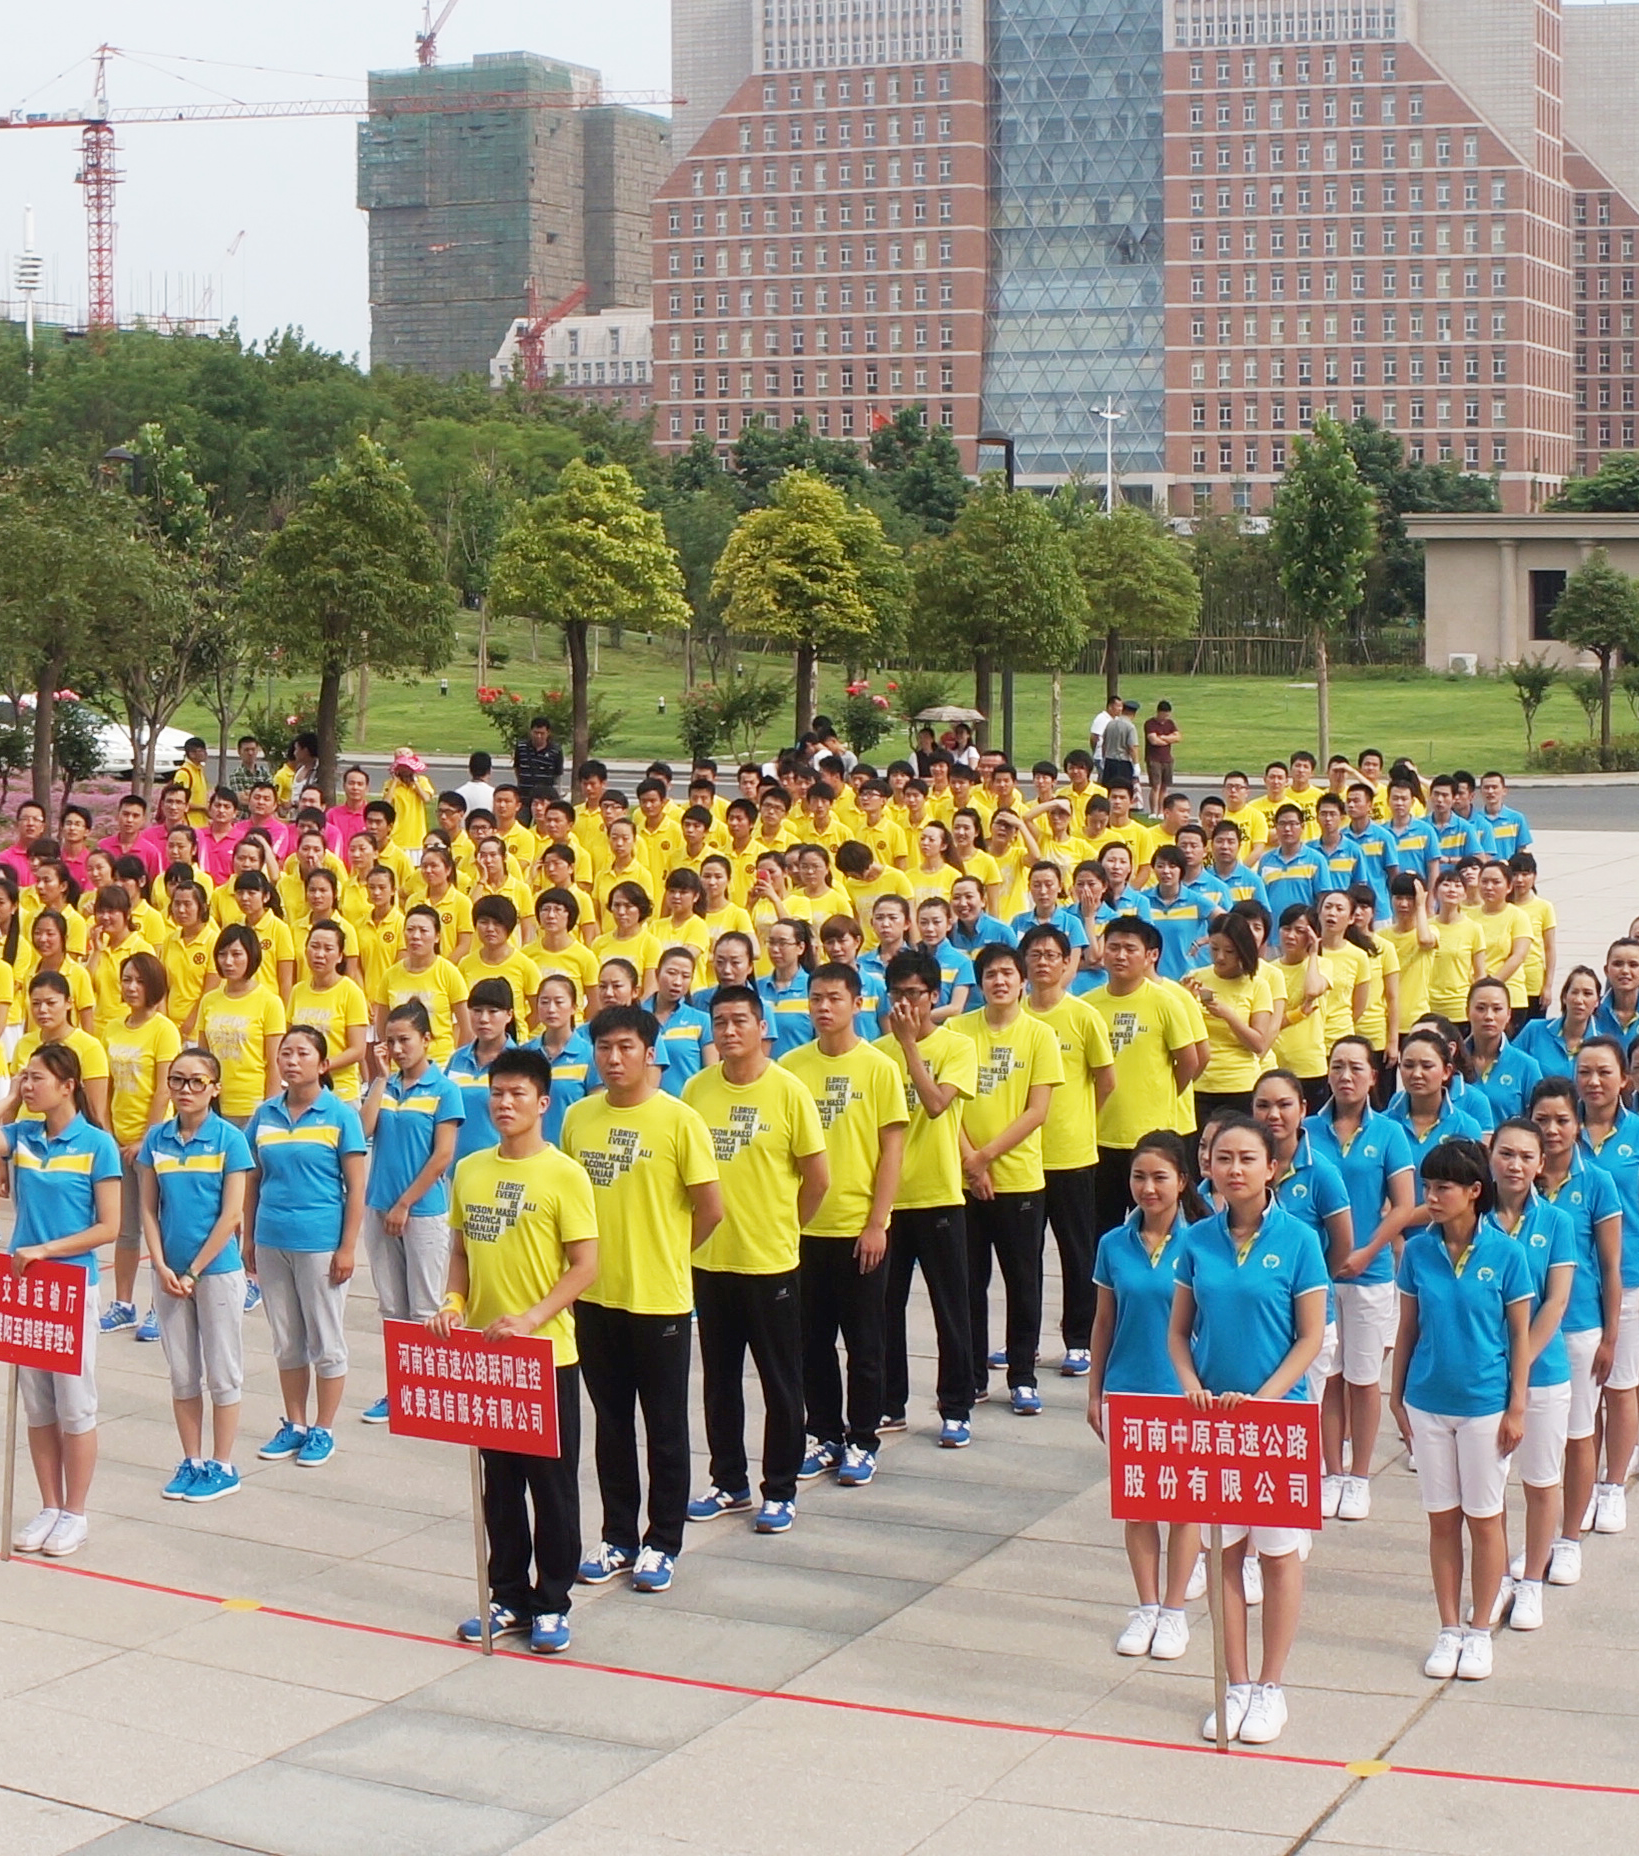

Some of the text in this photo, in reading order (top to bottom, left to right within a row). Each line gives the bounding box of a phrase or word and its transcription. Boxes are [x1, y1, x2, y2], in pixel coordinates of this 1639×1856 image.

[638, 1148, 653, 1159] ALI
[522, 1202, 537, 1212] ALI
[398, 1343, 542, 1391] 河南省高速公路联网监控
[401, 1384, 543, 1435] 收费通信服务有限公司
[1123, 1416, 1309, 1461] 河南中原高速公路
[1124, 1464, 1309, 1509] 股份有限公司
[716, 1490, 734, 1508] N
[609, 1550, 626, 1568] N
[496, 1609, 516, 1628] N
